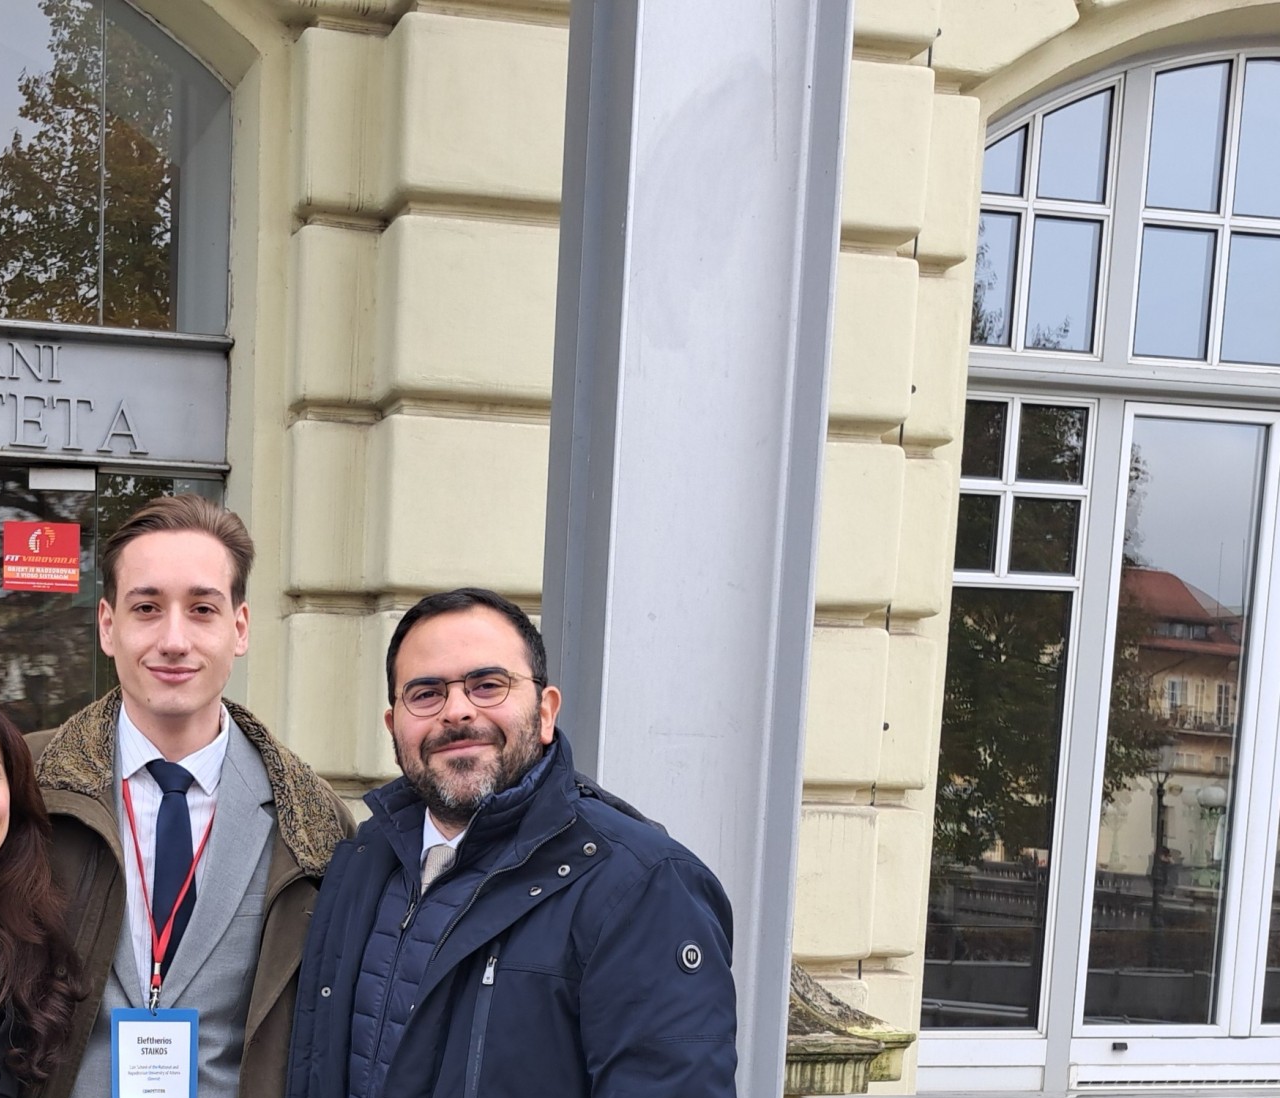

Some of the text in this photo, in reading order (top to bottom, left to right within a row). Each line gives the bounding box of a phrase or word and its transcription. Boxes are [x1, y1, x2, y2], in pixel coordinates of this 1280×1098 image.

[5, 554, 79, 565] FIT VAROVANJE
[136, 1036, 172, 1045] Eleftherios
[141, 1047, 168, 1055] STAIKOS
